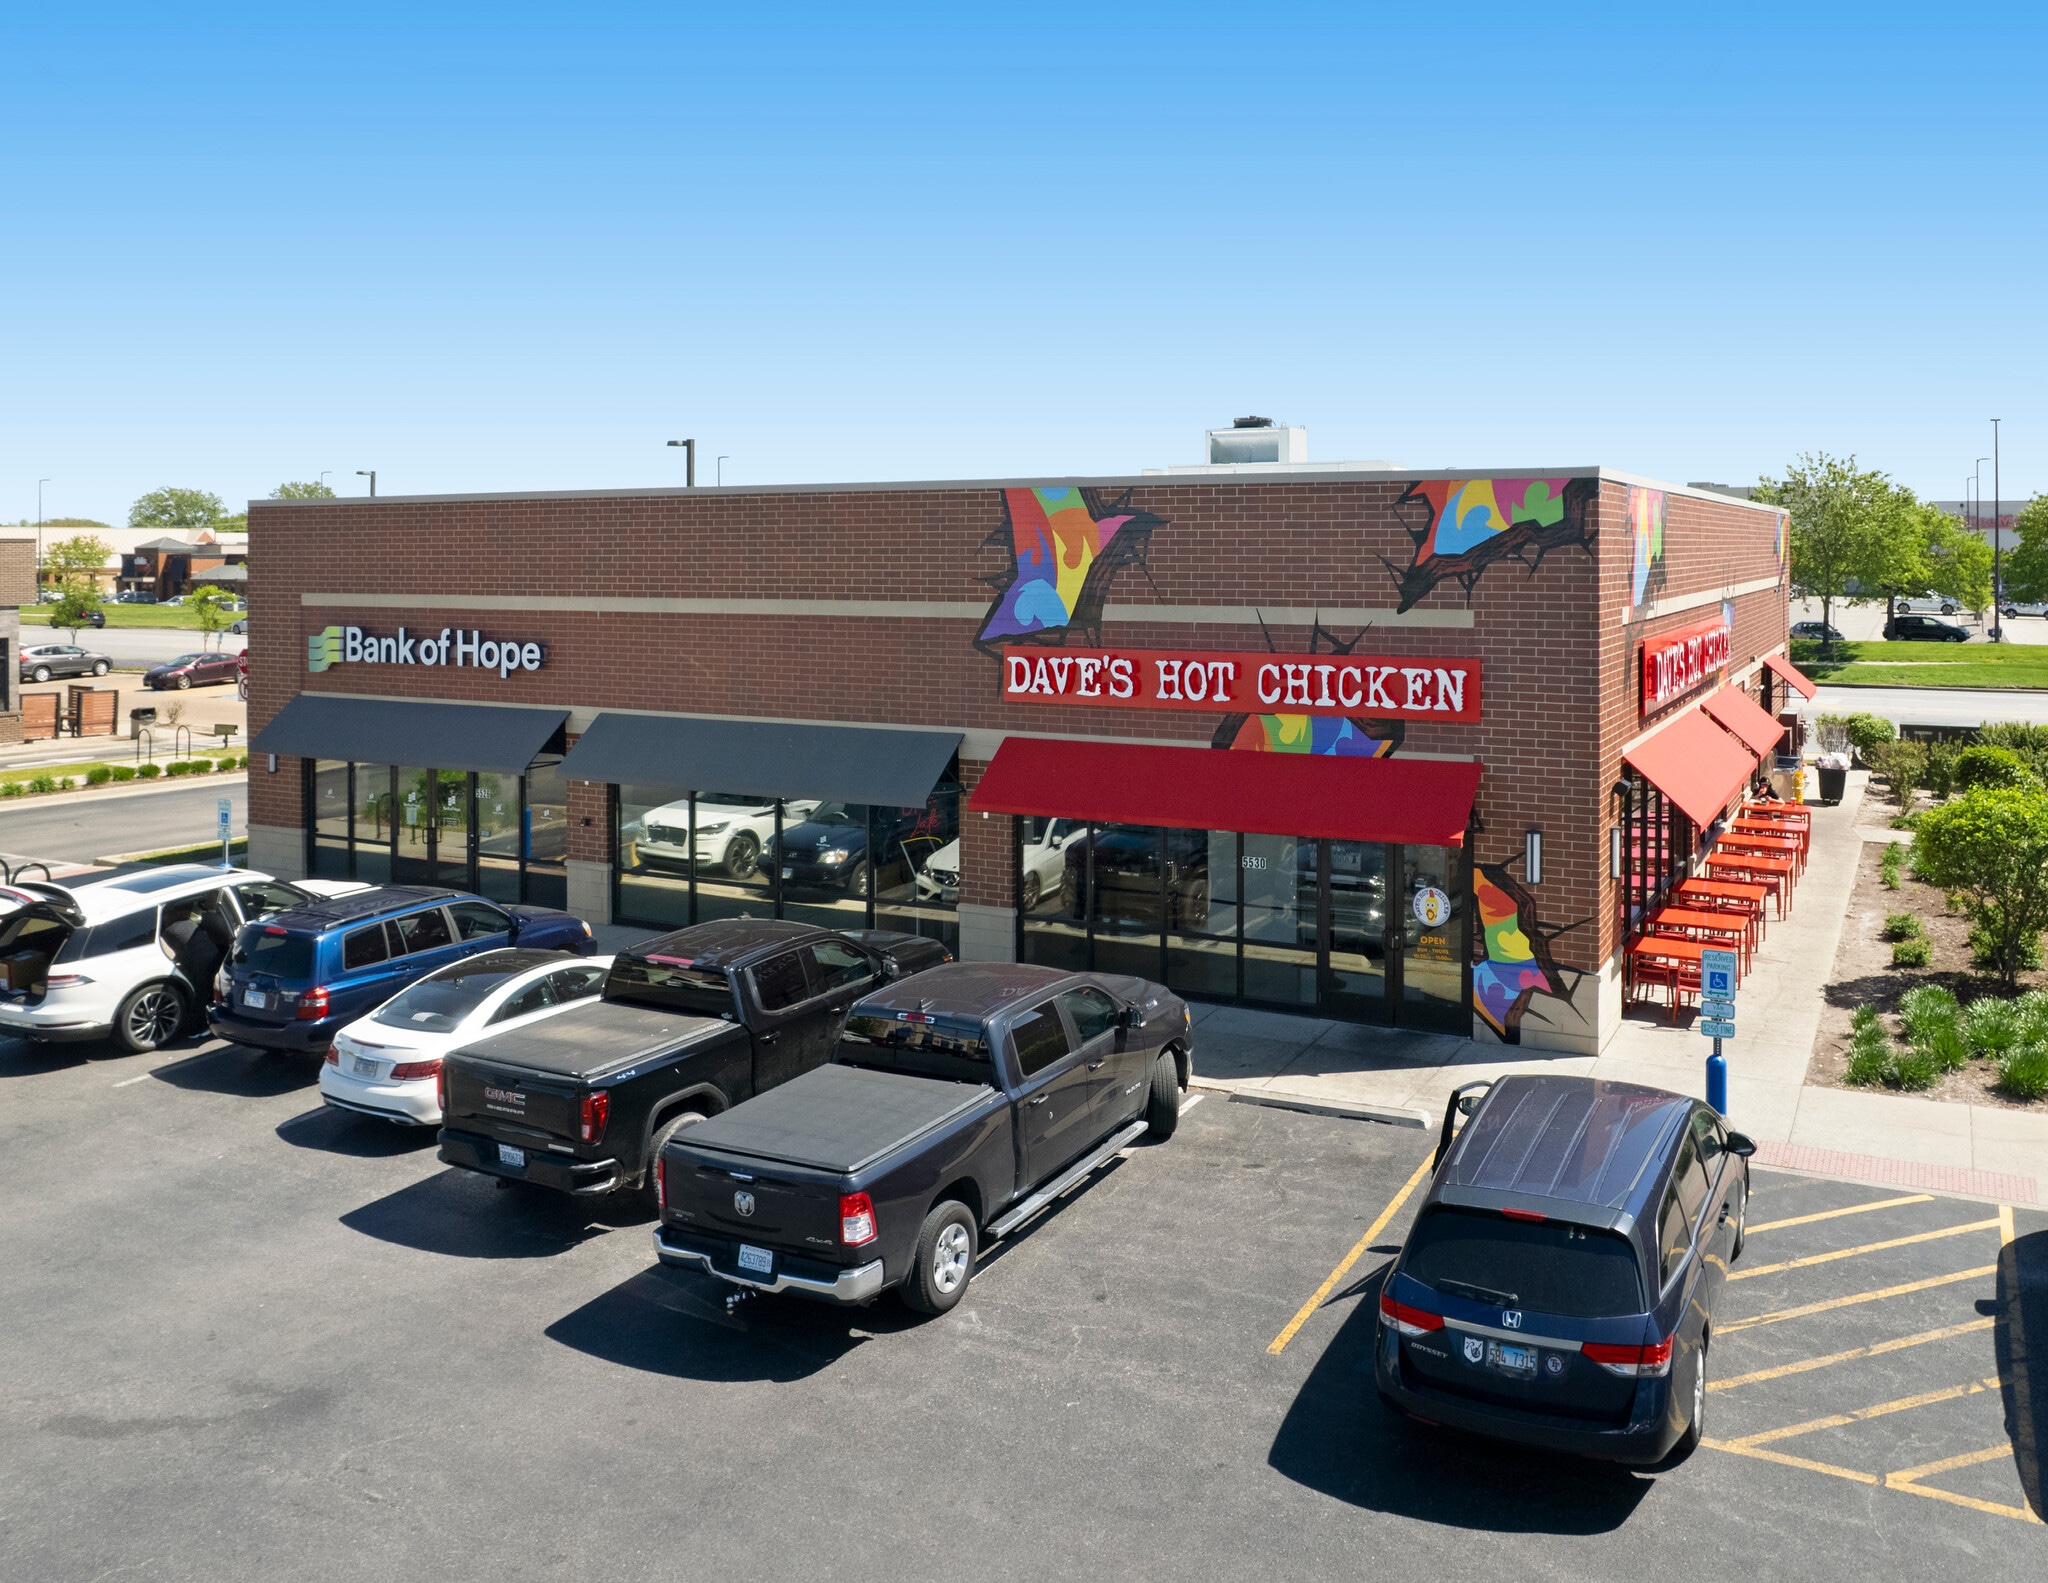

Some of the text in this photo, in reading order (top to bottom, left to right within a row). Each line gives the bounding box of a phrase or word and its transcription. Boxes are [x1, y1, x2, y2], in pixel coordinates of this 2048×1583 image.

[346, 626, 541, 679] Bank of Hope
[240, 656, 248, 667] ST
[1007, 655, 1468, 713] DAVE'S HOT CHICKEN
[1243, 857, 1266, 868] 5530
[1420, 936, 1446, 945] OPEN
[1704, 953, 1734, 963] RESERVED
[1706, 962, 1731, 971] PARKING
[1703, 1023, 1733, 1035] $250 FINE
[485, 1086, 526, 1106] GMC
[486, 1103, 525, 1115] SIERRA
[1411, 1342, 1448, 1358] ODYSSEY
[1513, 1351, 1536, 1369] 7315
